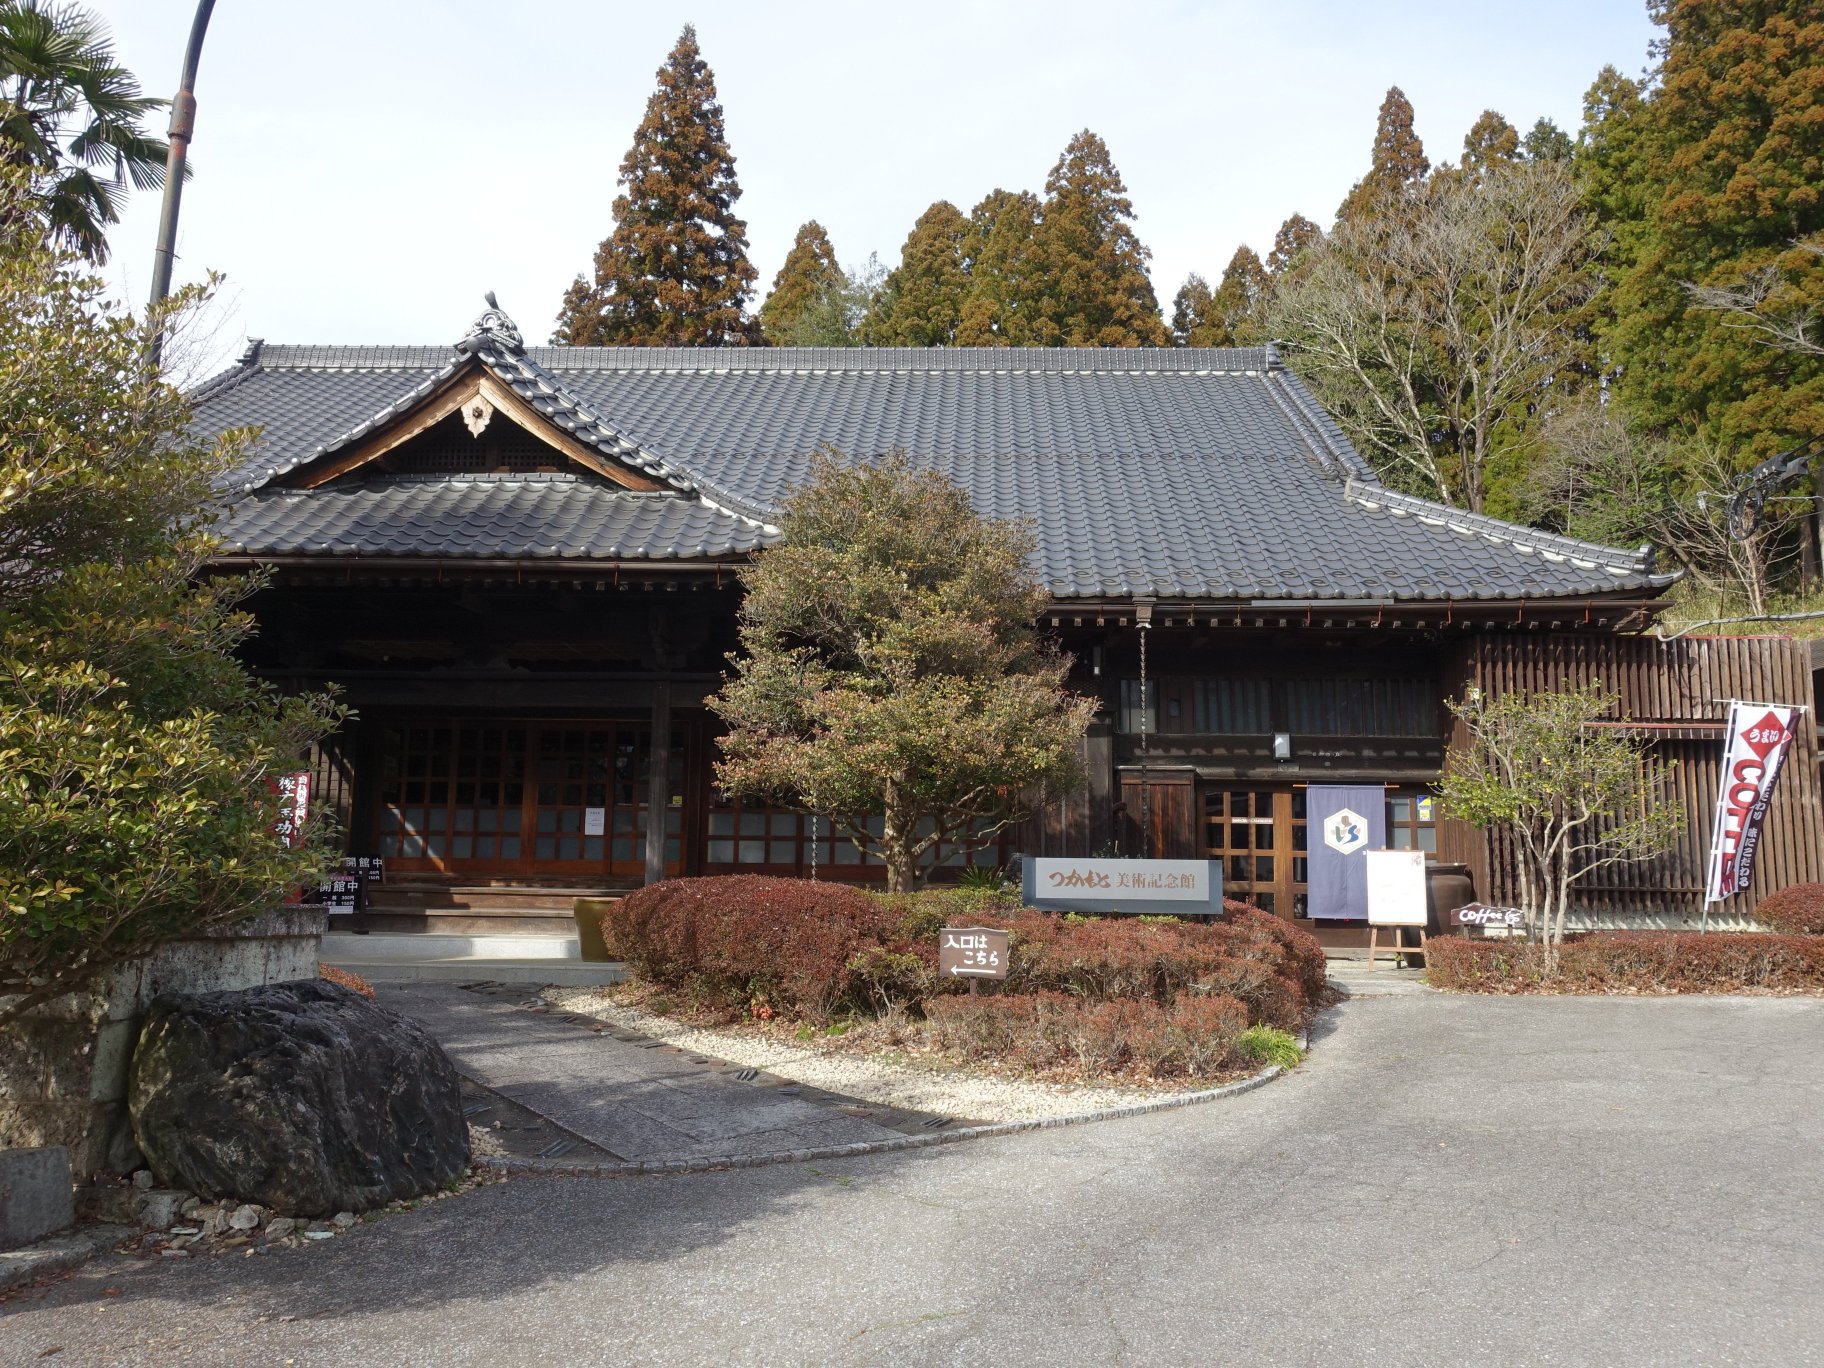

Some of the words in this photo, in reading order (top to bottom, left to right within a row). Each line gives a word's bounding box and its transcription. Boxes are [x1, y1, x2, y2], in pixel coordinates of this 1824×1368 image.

[346, 857, 383, 868] 開館中
[1738, 827, 1759, 887] 味にこだわる
[1048, 868, 1112, 889] つかもと
[1116, 872, 1195, 889] 美術記念館
[319, 880, 359, 893] 開館中
[943, 934, 988, 949] 入口は
[963, 950, 999, 966] こちら
